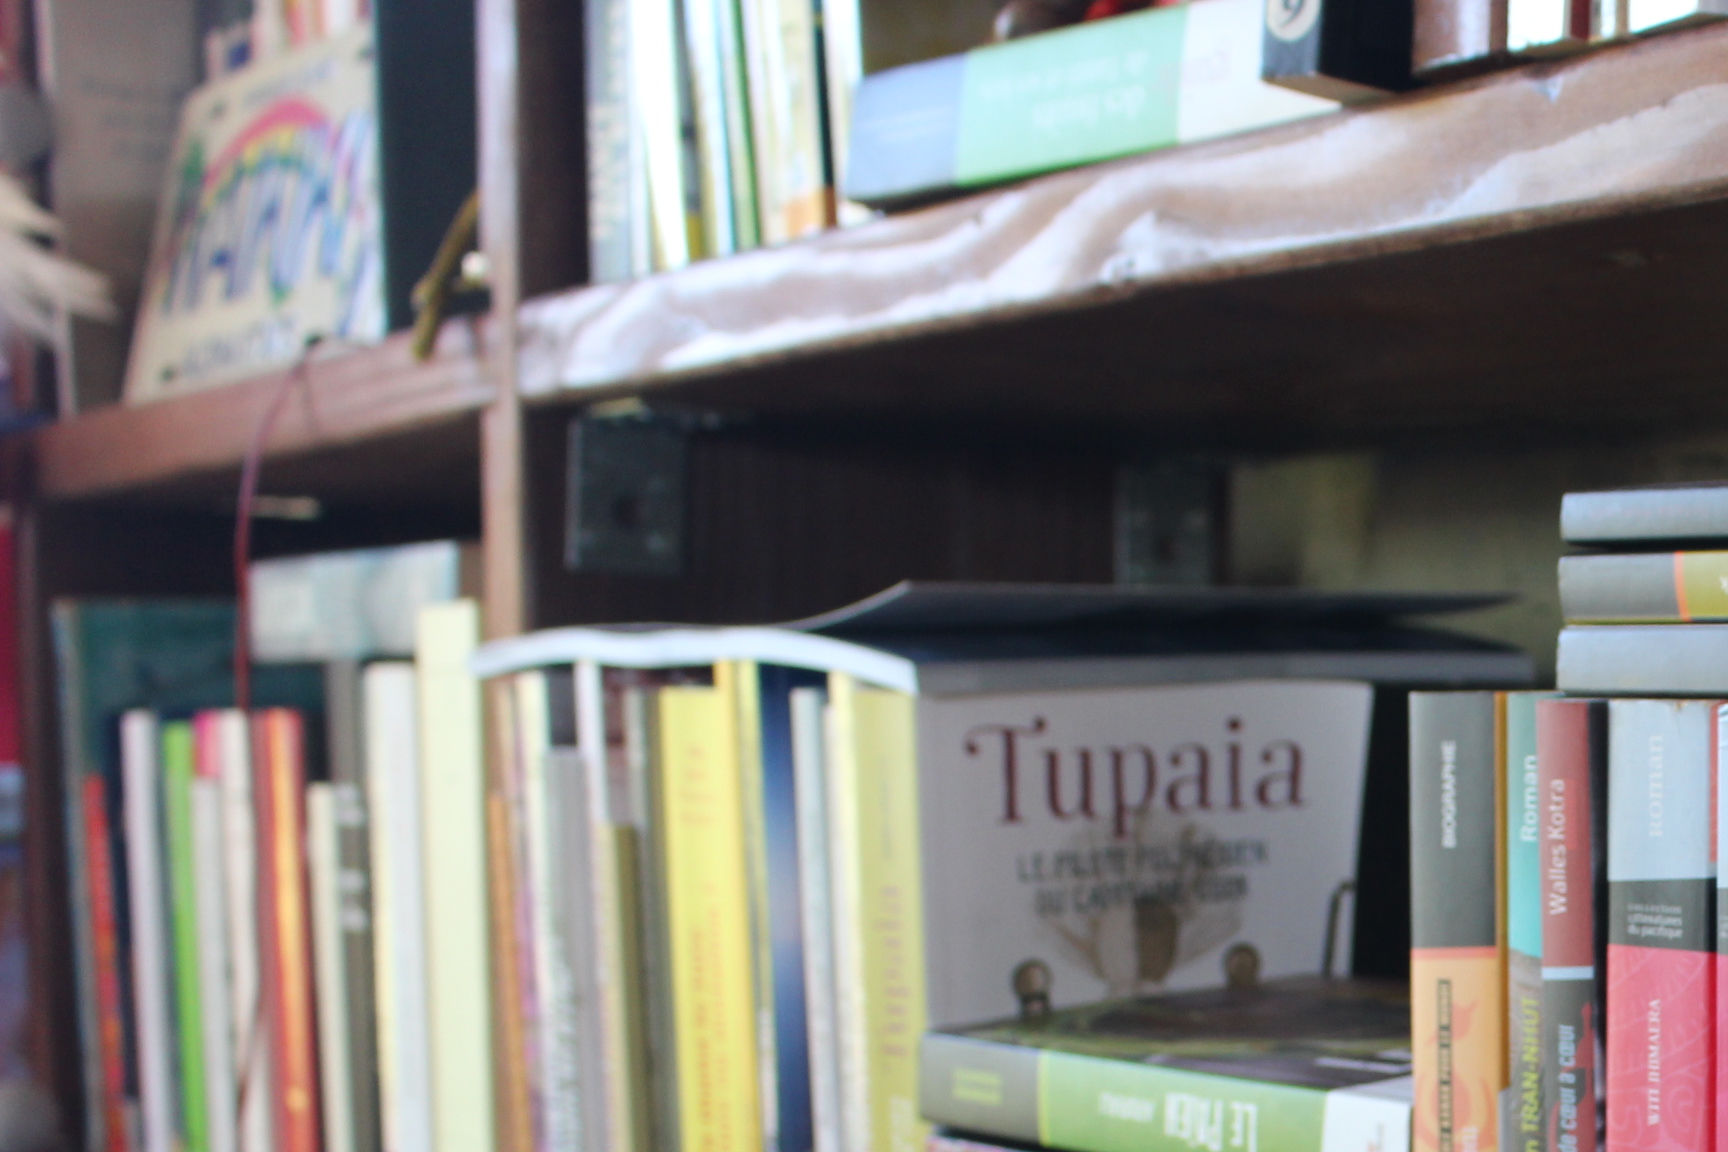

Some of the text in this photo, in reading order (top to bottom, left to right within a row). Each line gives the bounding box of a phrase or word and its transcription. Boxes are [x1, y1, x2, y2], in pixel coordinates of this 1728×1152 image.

[964, 716, 1307, 839] Tupaia
[1520, 755, 1538, 842] Roman
[1548, 778, 1568, 915] Walles Kotra
